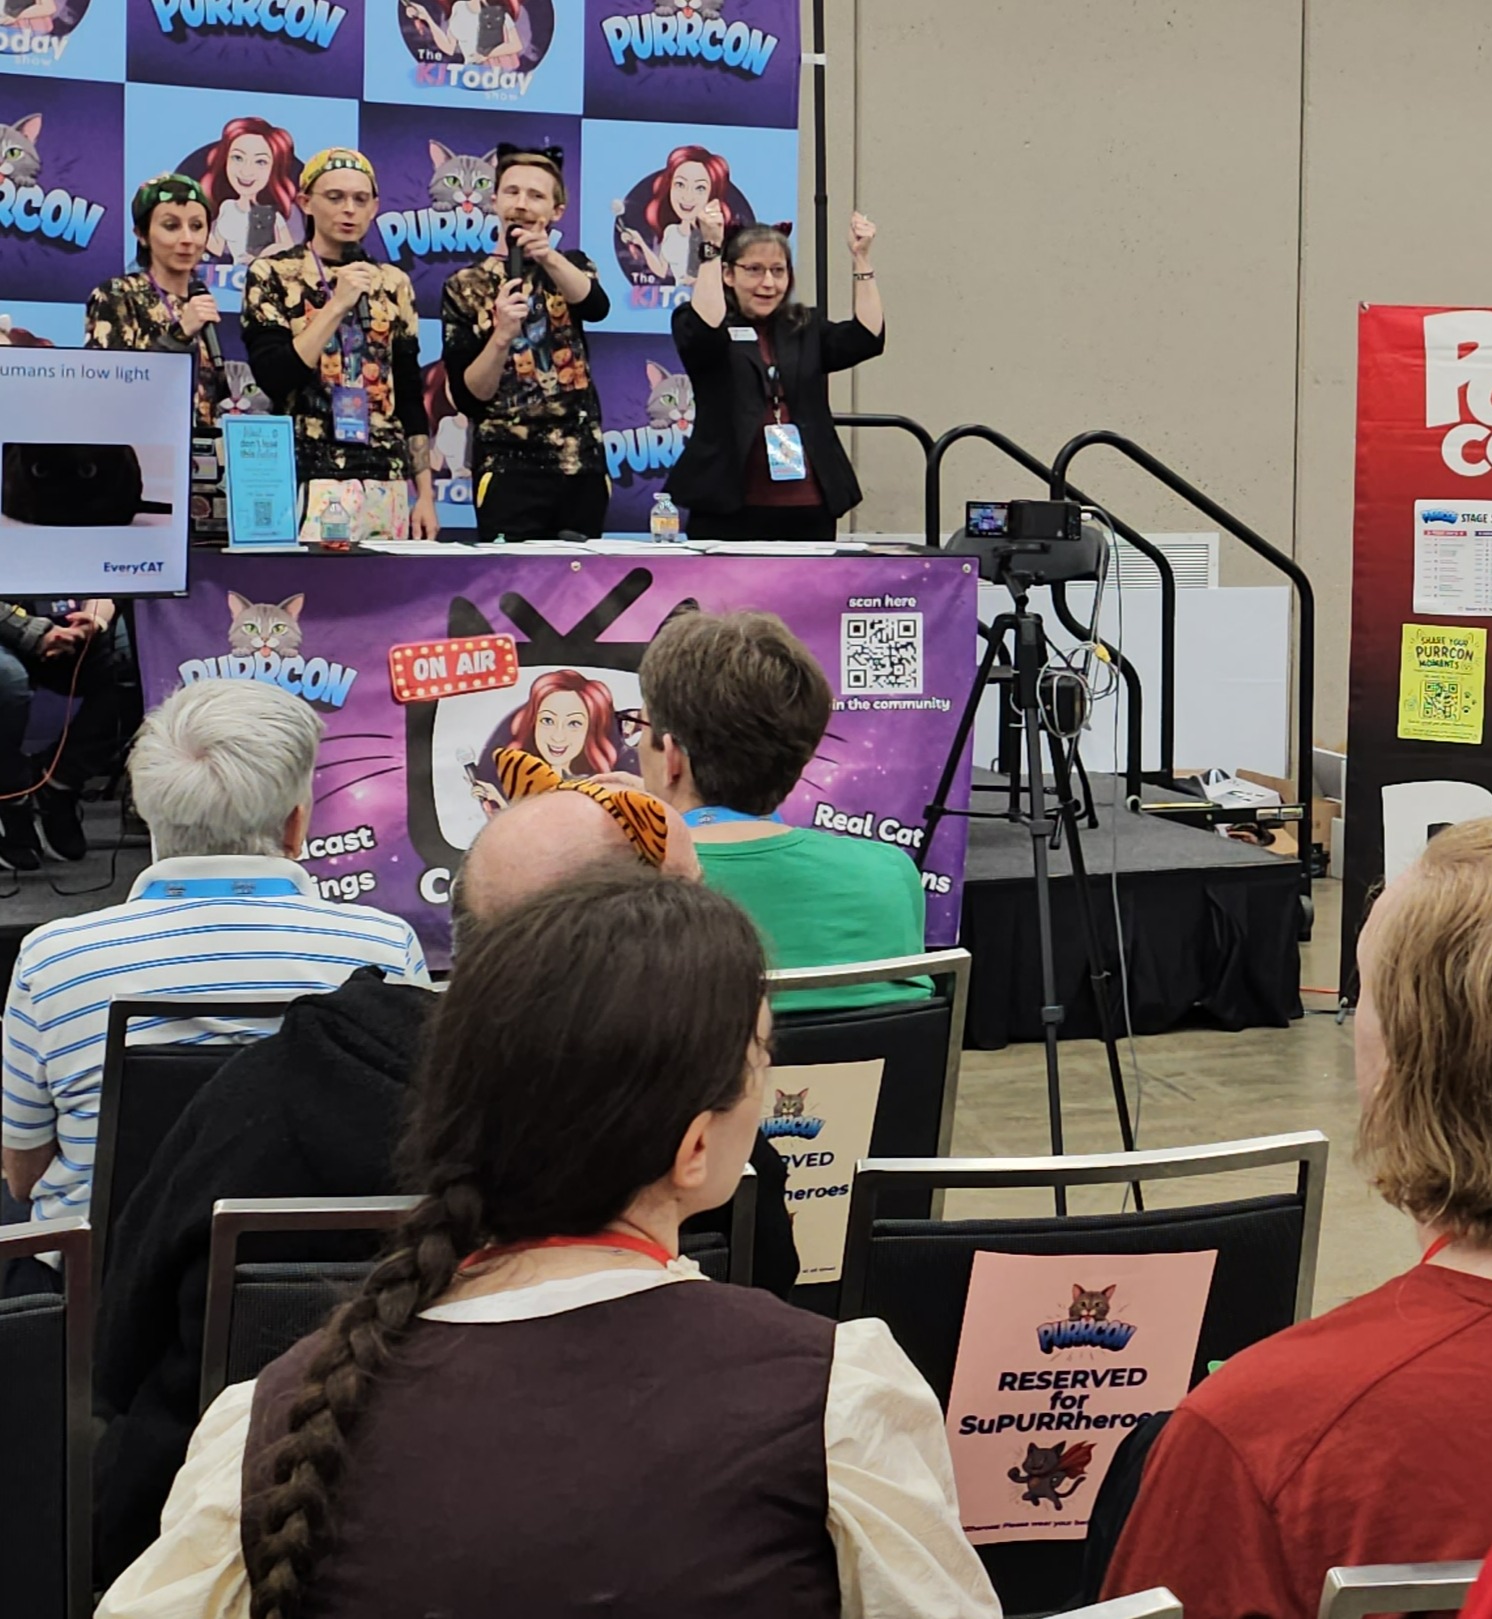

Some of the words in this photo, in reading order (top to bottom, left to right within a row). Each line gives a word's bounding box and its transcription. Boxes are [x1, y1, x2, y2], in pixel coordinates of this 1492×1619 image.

[0, 27, 69, 60] day
[417, 48, 443, 61] The
[601, 11, 779, 76] PURRCON
[376, 206, 562, 263] PURRC
[631, 271, 656, 284] The
[630, 283, 692, 309] KJTo
[61, 363, 75, 379] in
[81, 364, 111, 380] low
[116, 365, 151, 384] light
[1461, 513, 1488, 524] STAGE
[103, 561, 165, 575] EveryCAT
[848, 596, 882, 608] scan
[884, 594, 917, 608] here
[412, 655, 448, 681] ON
[456, 649, 497, 675] AIR
[1415, 645, 1474, 662] PURRCON
[847, 697, 870, 711] the
[873, 697, 951, 712] community
[813, 802, 875, 838] Real
[878, 818, 925, 848] Cat
[761, 1116, 826, 1140] URRCON
[1037, 1320, 1137, 1353] PURRCON
[998, 1367, 1148, 1392] RESERVED
[1049, 1390, 1090, 1411] for
[958, 1410, 1153, 1435] SuPURRhero
